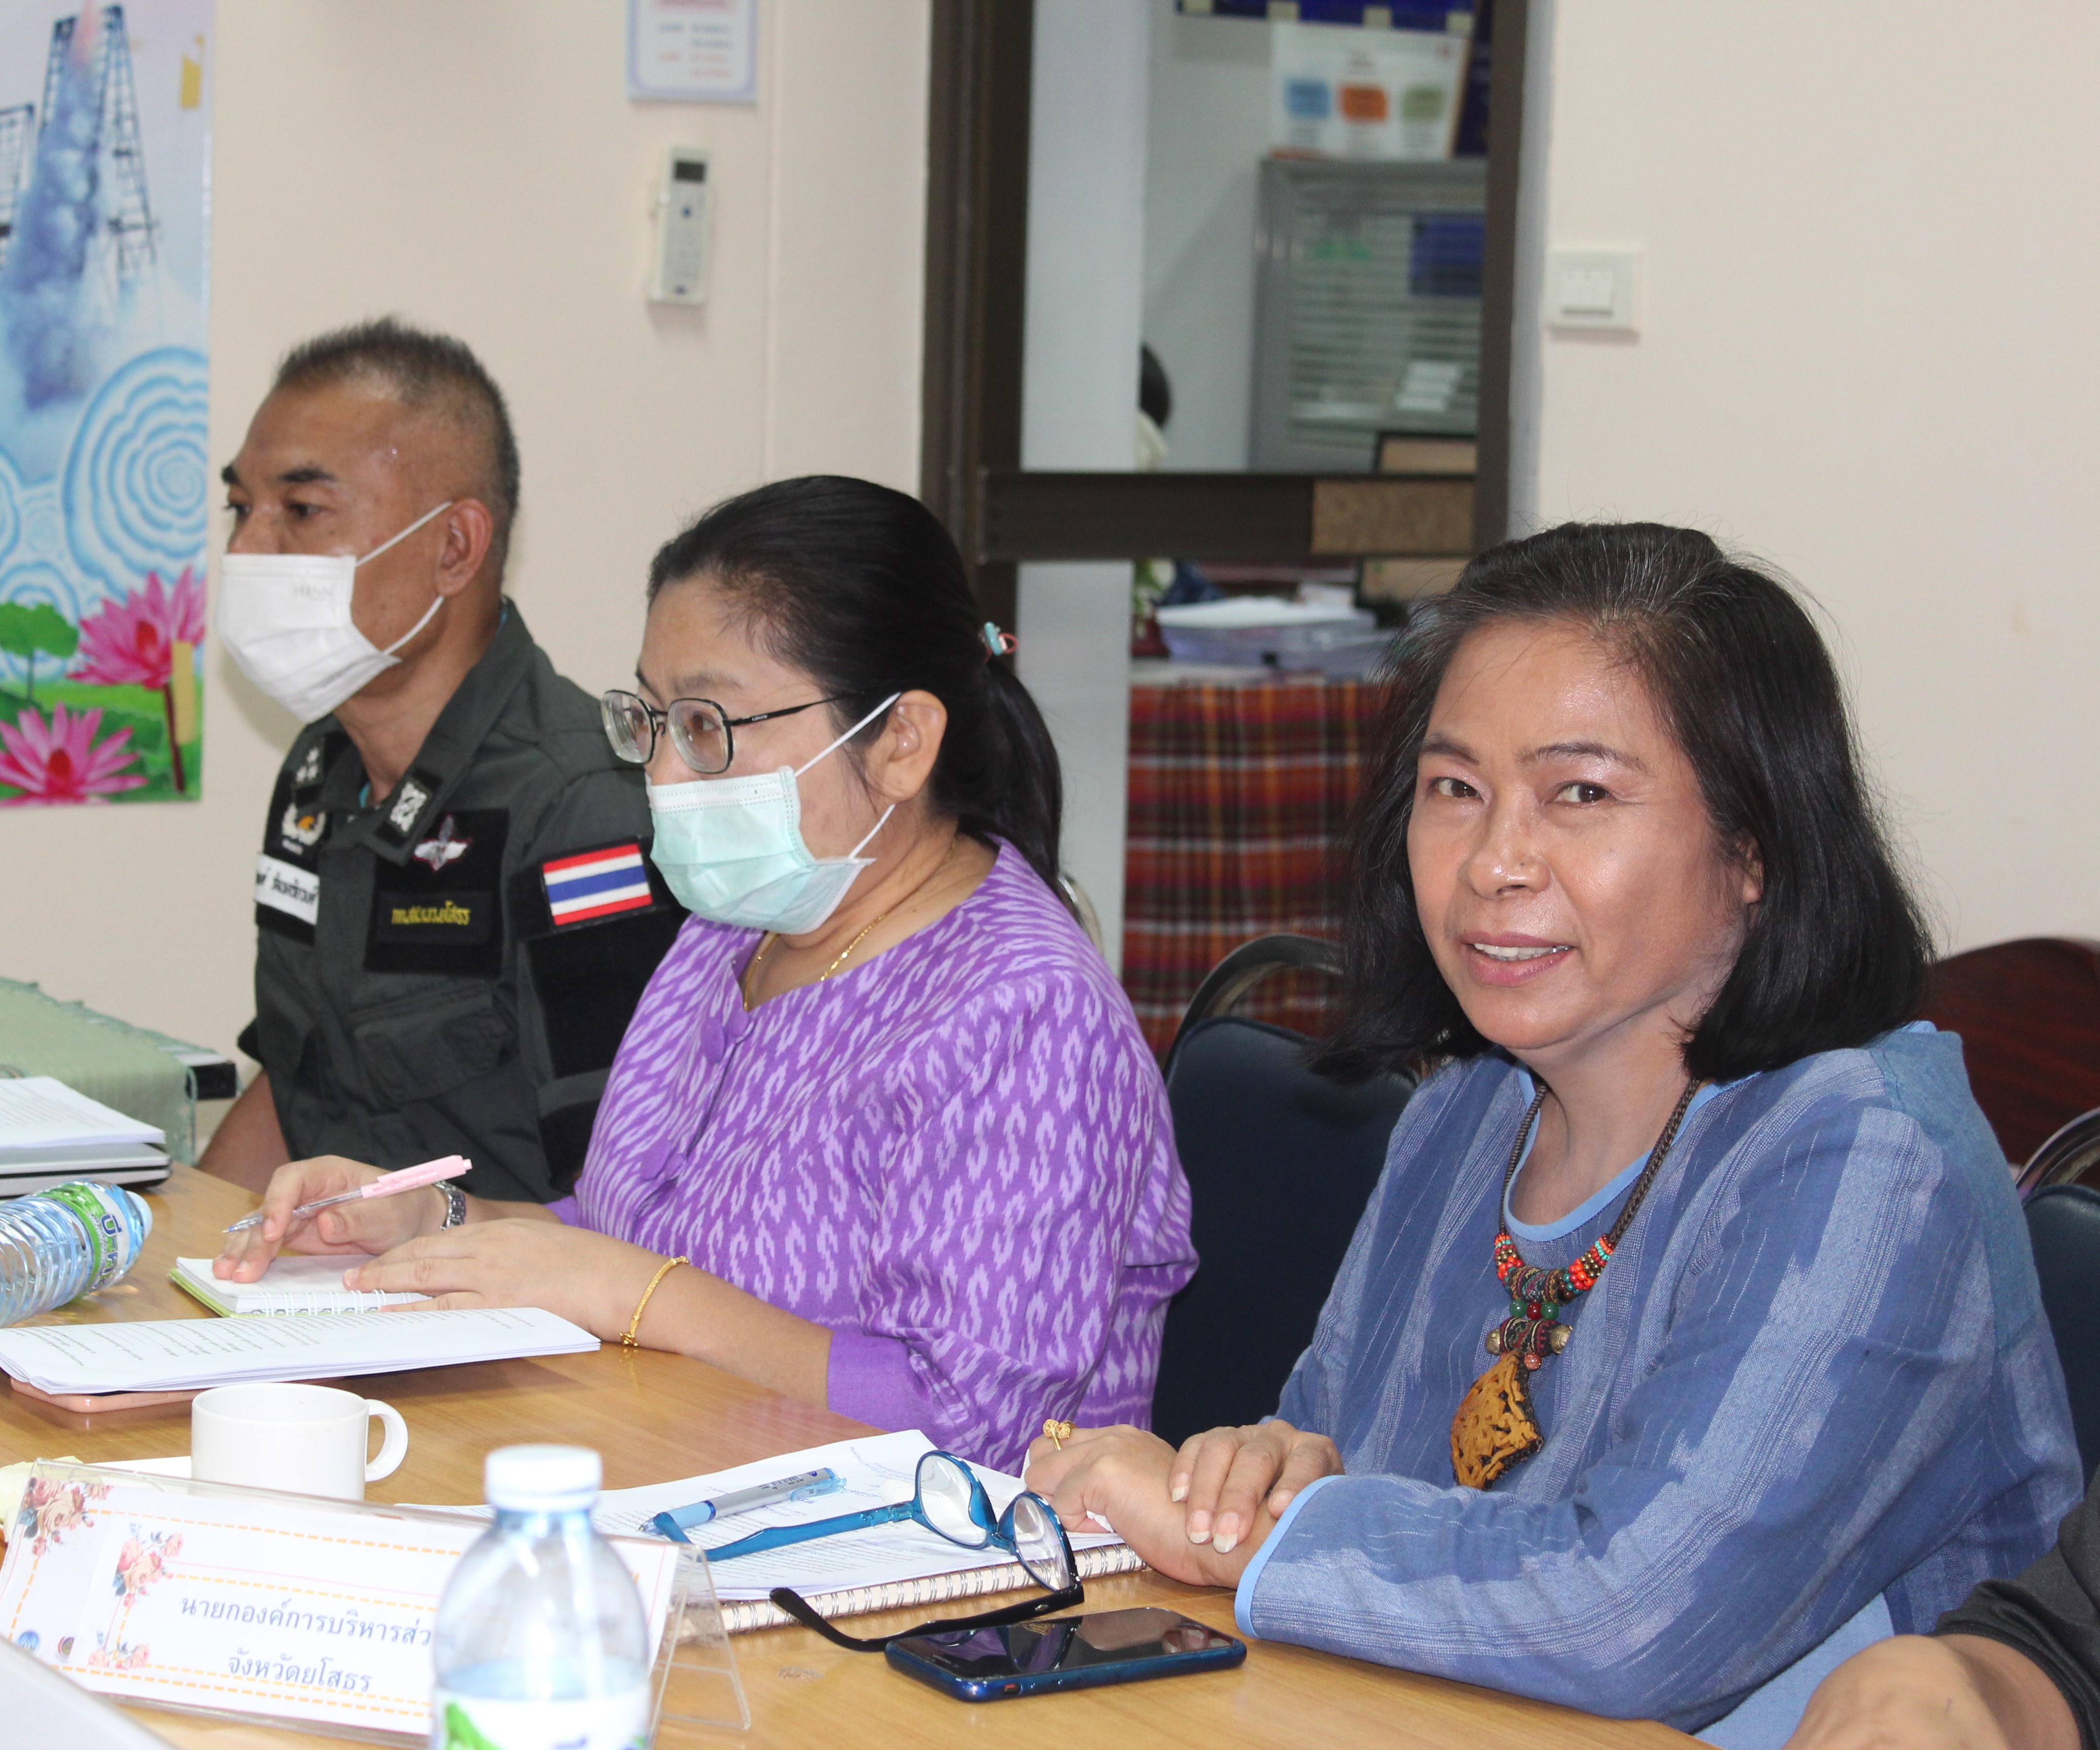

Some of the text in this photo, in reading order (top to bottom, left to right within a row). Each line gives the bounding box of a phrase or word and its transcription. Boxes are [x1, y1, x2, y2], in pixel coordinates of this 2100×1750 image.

[180, 1598, 433, 1646] นายกองค์การบริหารส่ว
[228, 1647, 372, 1692] จังหวัดยโสธร
